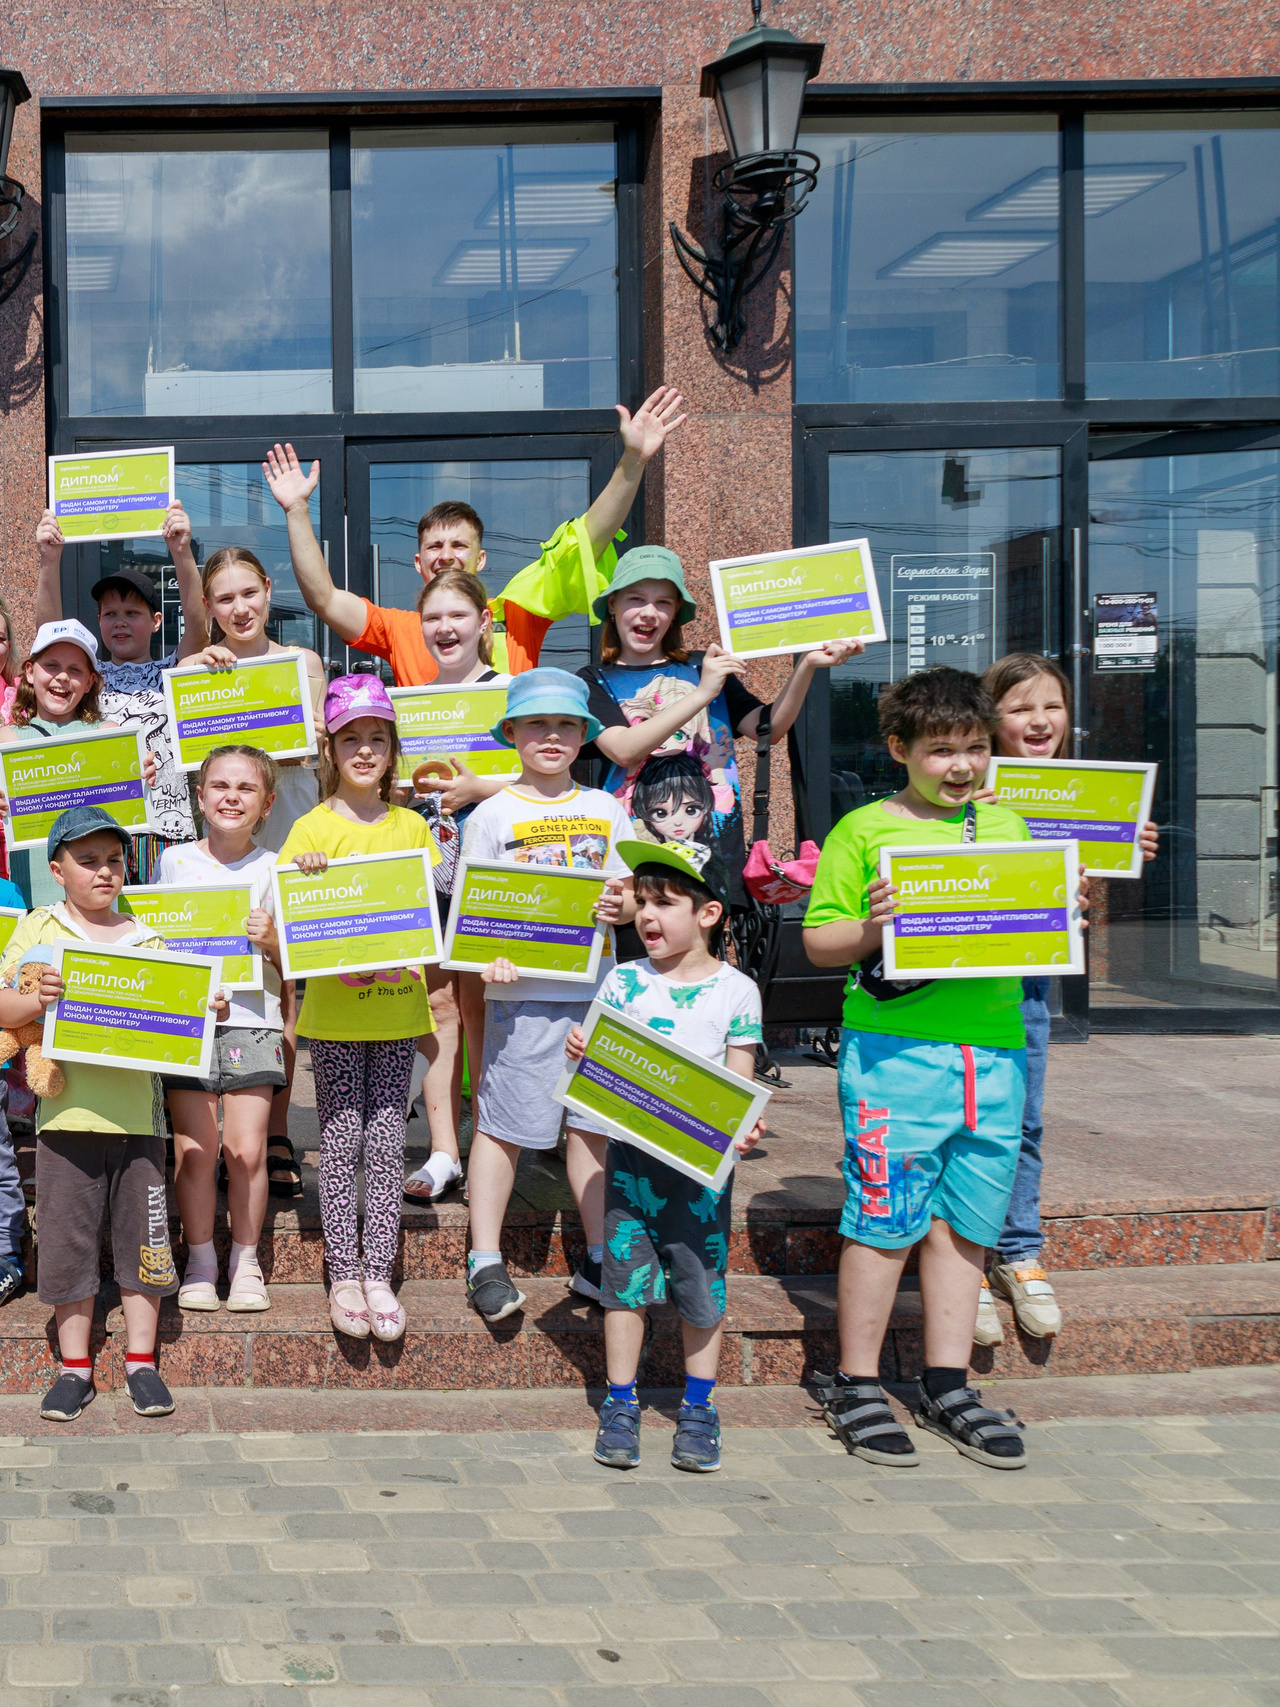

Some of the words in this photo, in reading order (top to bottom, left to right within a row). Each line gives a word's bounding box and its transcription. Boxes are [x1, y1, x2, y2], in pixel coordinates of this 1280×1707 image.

[60, 473, 118, 487] ДИПЛОМ
[108, 496, 156, 504] ТАЛАНТЛИВОМУ
[897, 566, 960, 580] Сормовские
[962, 566, 990, 579] Зори
[730, 575, 801, 596] ДИПЛОМ
[908, 594, 940, 602] РЕЖИМ
[179, 686, 244, 706] ДИПЛОМ
[182, 720, 206, 728] ВЫДАН
[206, 716, 234, 725] САМОМУ
[236, 709, 289, 721] ТАЛАНТЛИВОМУ
[399, 709, 464, 724] ДИПЛОМ
[183, 727, 208, 735] ЮНОМУ
[210, 722, 248, 731] КОНДИТЕРУ
[12, 761, 80, 783] ДИПЛОМ
[15, 797, 40, 805] ВЫДАН
[41, 793, 70, 802] САМОМУ
[72, 784, 127, 798] ТАЛАНТЛИВОМУ
[997, 786, 1076, 801] ДИПЛОМ
[16, 804, 42, 812] ЮНОМУ
[44, 798, 85, 808] КОНДИТЕРУ
[544, 814, 588, 822] FUTURE
[531, 824, 602, 833] GENERATION
[523, 835, 564, 845] FEROCIOUS
[899, 877, 988, 895] ДИПЛОМ
[288, 885, 362, 906] ДИПЛОМ
[467, 887, 540, 904] ДИПЛОМ
[291, 923, 318, 931] ВЫДАН
[319, 919, 351, 929] САМОМУ
[353, 912, 414, 925] ТАЛАНТЛИВОМУ
[462, 918, 489, 926] ВЫДАН
[489, 921, 521, 929] САМОМУ
[521, 924, 580, 935] ТАЛАНТЛИВОМУ
[901, 917, 933, 925] ВЫДАН
[935, 915, 973, 923] САМОМУ
[975, 913, 1048, 922] ТАЛАНТЛИВОМУ
[292, 930, 321, 939] ЮНОМУ
[323, 925, 367, 936] КОНДИТЕРУ
[490, 929, 533, 938] КОНДИТЕРУ
[938, 923, 991, 932] КОНДИТЕРУ
[67, 970, 145, 991] ДИПЛОМ
[358, 988, 372, 1000] of
[378, 987, 394, 996] the
[398, 985, 414, 995] box
[63, 1011, 93, 1020] ЮНОМУ
[95, 1015, 140, 1027] КОНДИТЕРУ
[64, 1003, 92, 1013] ВЫДАН
[93, 1007, 126, 1017] САМОМУ
[127, 1012, 189, 1026] ТАЛАНТЛИВОМУ
[594, 1035, 677, 1085] ДИПЛОМ
[582, 1067, 613, 1087] ЮНОМУ
[613, 1085, 661, 1114] КОНДИТЕРУ
[585, 1061, 614, 1081] ВЫДАН
[613, 1077, 649, 1100] САМОМУ
[648, 1096, 715, 1137] ТАЛАНТЛИВОМУ
[856, 1098, 890, 1219] HEAT
